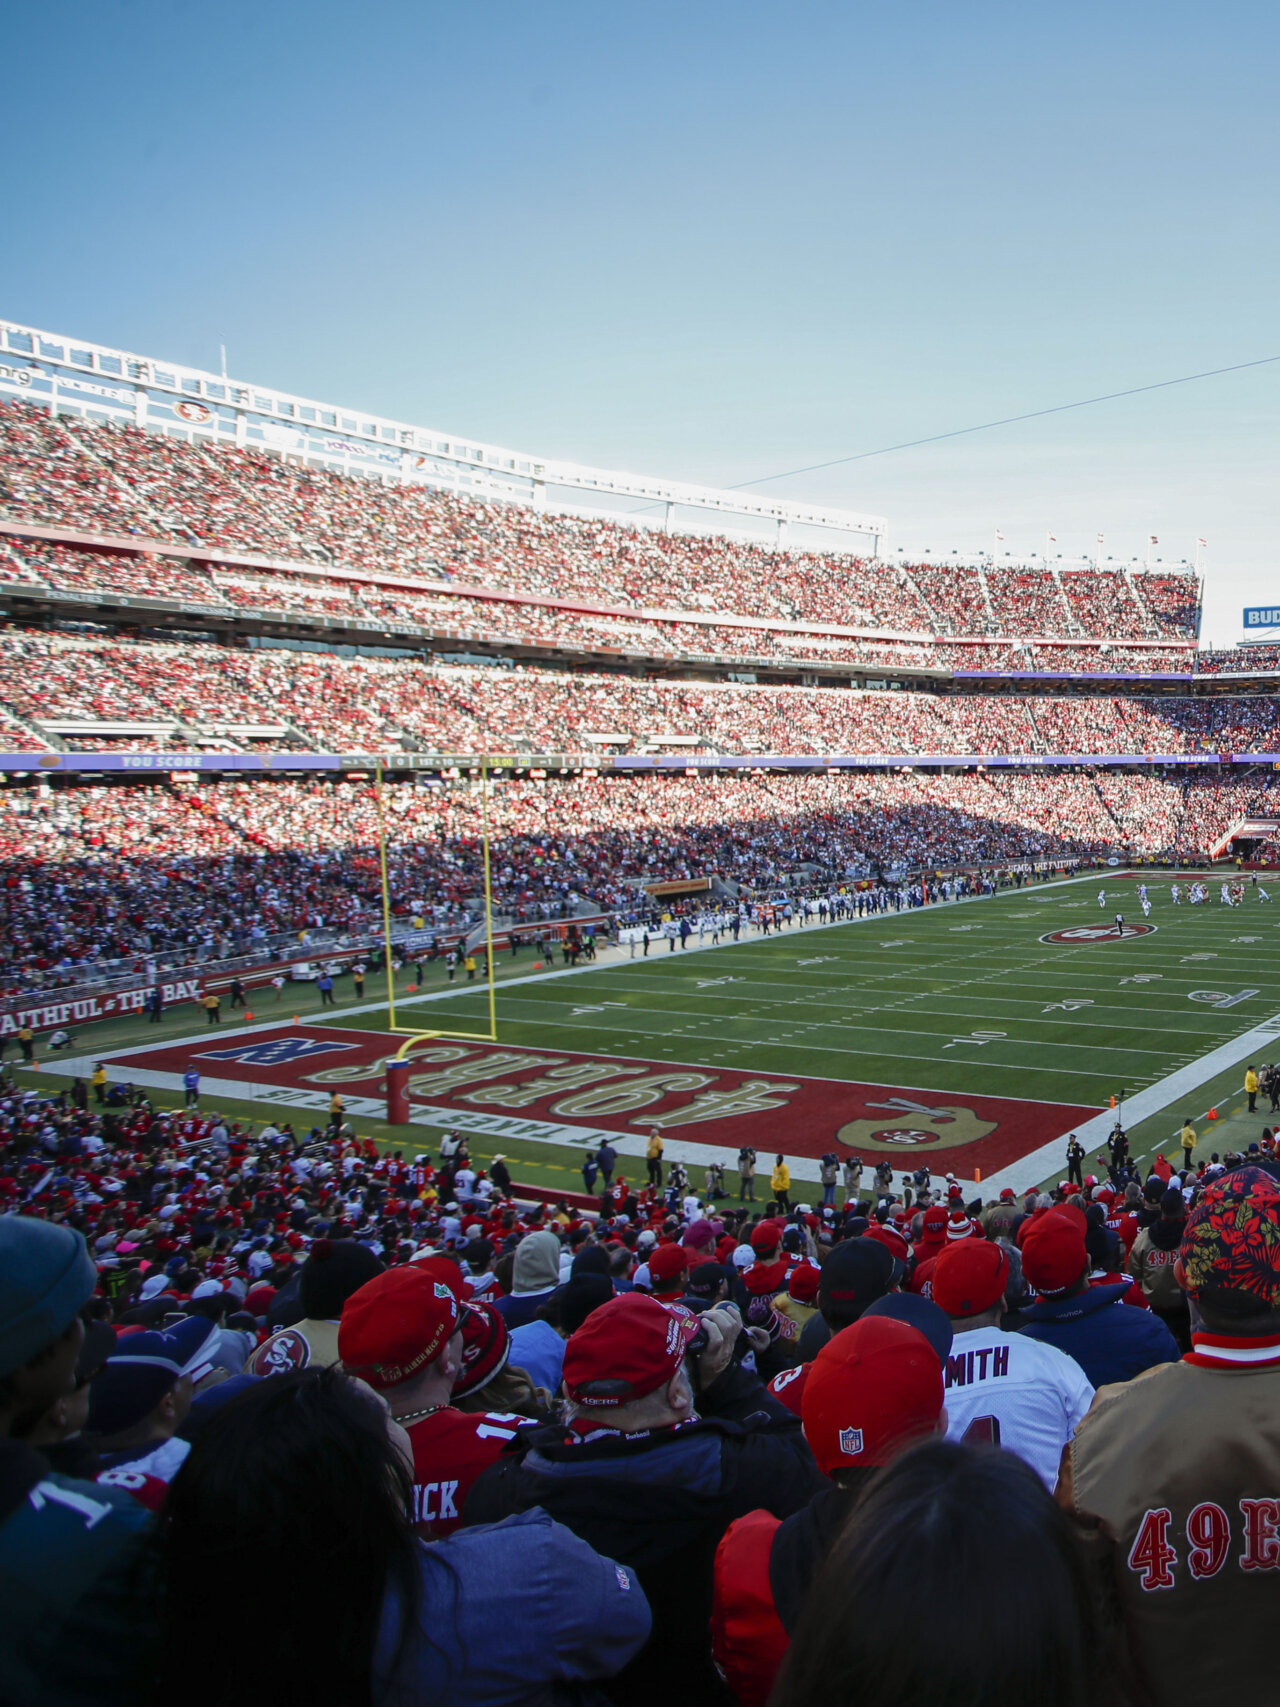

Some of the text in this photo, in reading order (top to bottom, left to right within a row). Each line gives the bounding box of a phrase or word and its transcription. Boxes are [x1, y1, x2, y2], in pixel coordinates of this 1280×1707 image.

[390, 625, 421, 636] STATE
[122, 757, 203, 767] YOU SCORE
[489, 757, 513, 767] 15:00
[686, 758, 720, 766] YOU SCORE
[855, 756, 889, 765] YOU SCORE
[1008, 756, 1043, 764] YOU SCORE
[0, 997, 103, 1034] AITHFUL
[161, 980, 204, 1003] BAY
[438, 1109, 571, 1141] TAKES
[572, 1132, 627, 1148] IT
[1146, 1249, 1180, 1267] 49E
[1055, 1309, 1084, 1319] NAUTICA
[945, 1345, 1010, 1389] MITH
[580, 1396, 620, 1406] 49ERS
[843, 1439, 861, 1450] NFL
